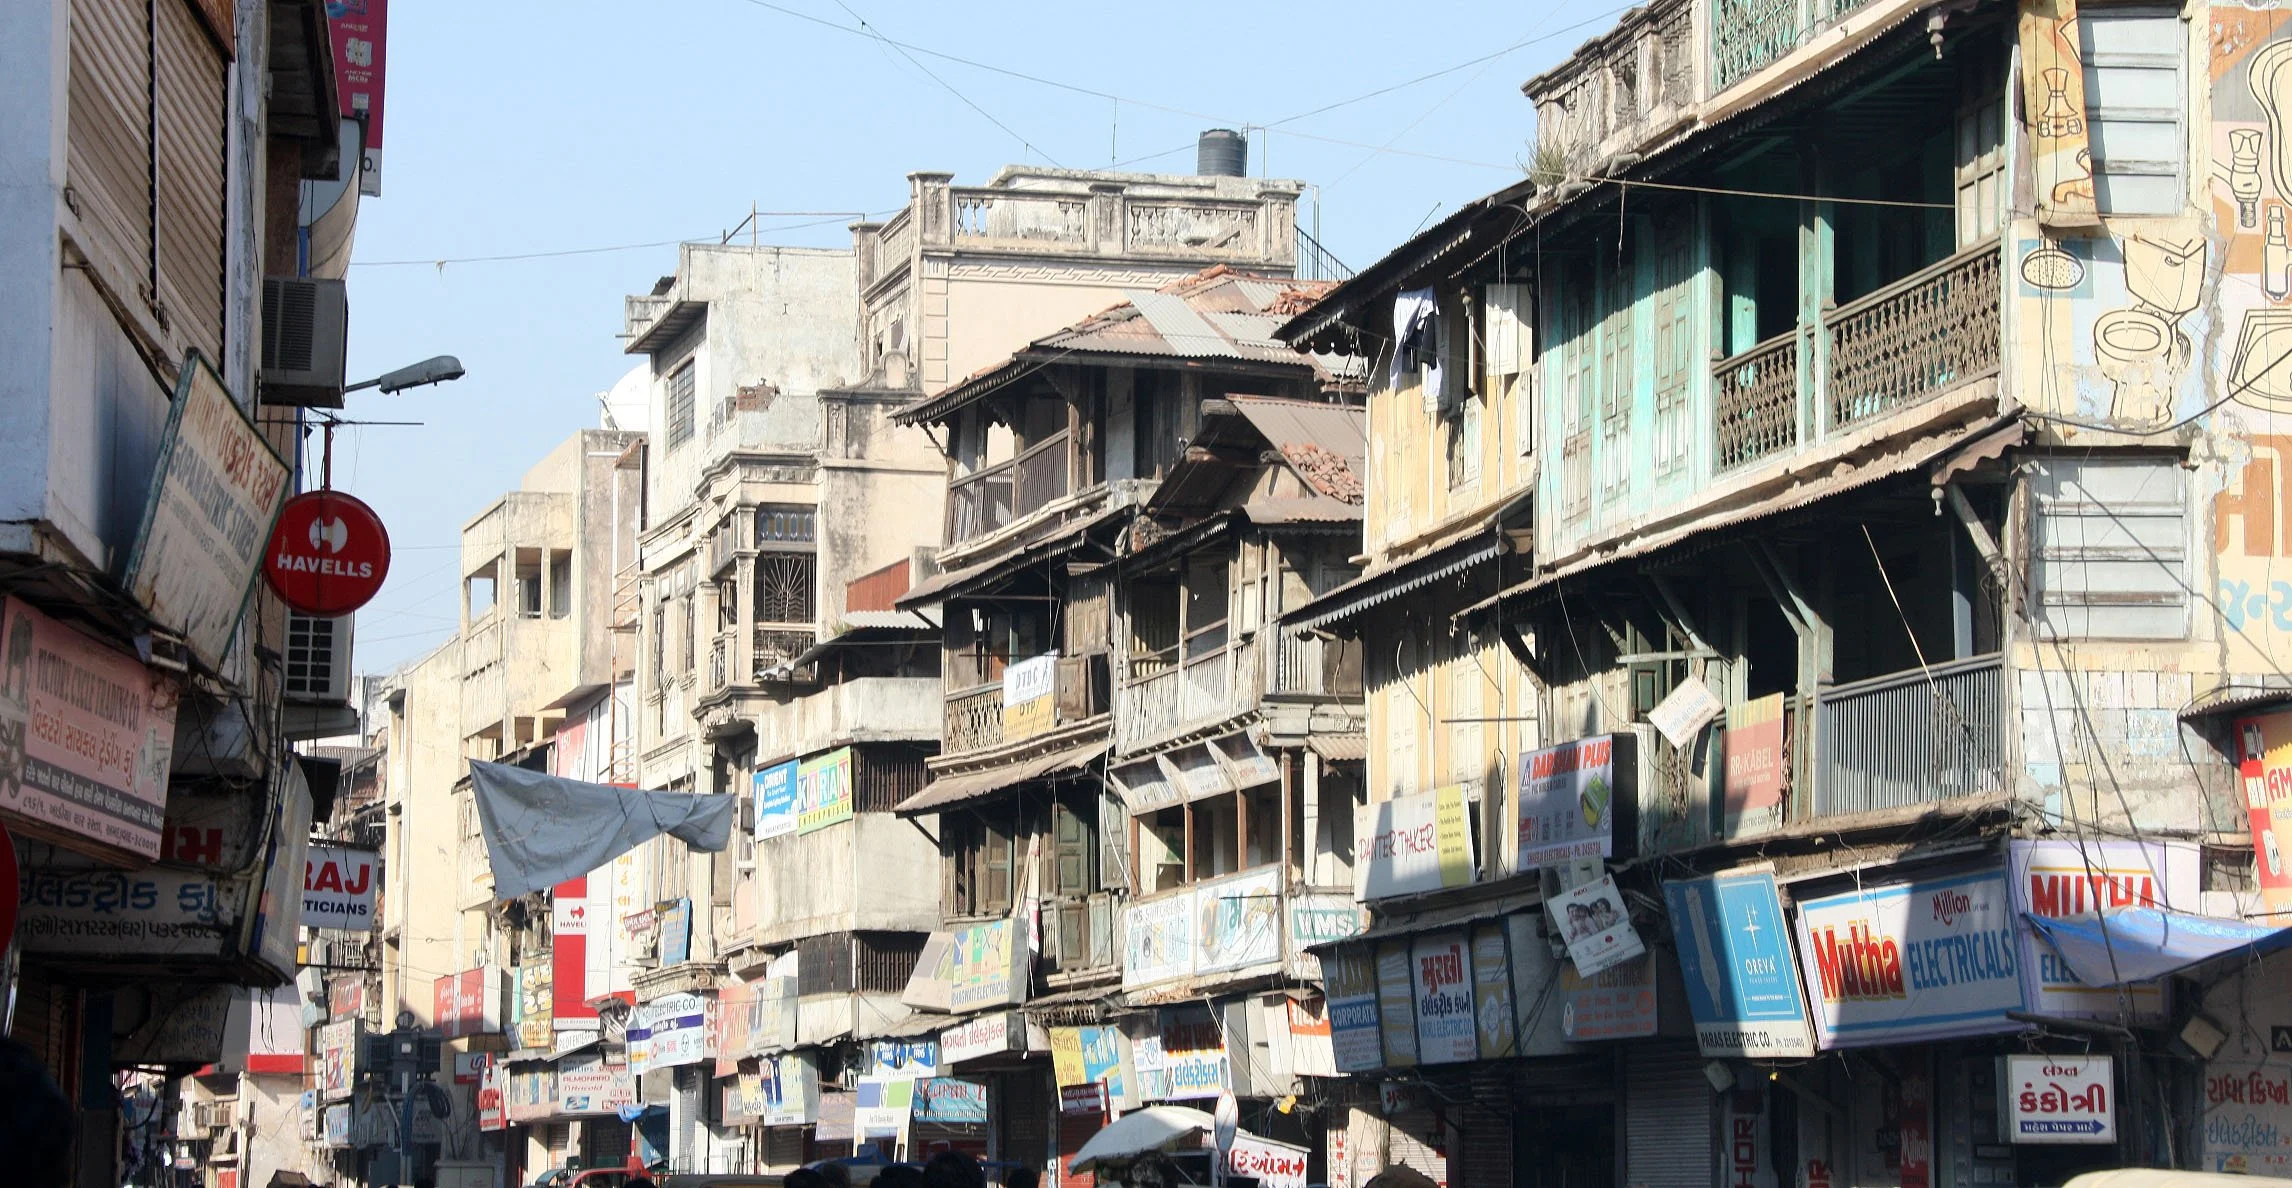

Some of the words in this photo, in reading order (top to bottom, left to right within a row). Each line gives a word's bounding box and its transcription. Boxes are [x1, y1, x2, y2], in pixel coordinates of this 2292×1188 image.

[277, 553, 373, 578] HAVELLS
[1532, 746, 1581, 781] DARSHAN
[1583, 739, 1612, 769] PLUS
[303, 899, 367, 916] TICIANS
[1932, 890, 1971, 926] Million
[2030, 874, 2155, 918] MUTHA
[1746, 955, 1776, 975] OREVA
[1811, 919, 1906, 1003] Mutha
[1907, 928, 2015, 990] ELECTRICALS
[1700, 1032, 1734, 1049] PARAS
[1733, 1031, 1759, 1048] ELECTRIC
[1759, 1031, 1773, 1048] CO.
[2043, 1065, 2078, 1077] લગ્ન
[2020, 1082, 2106, 1113] કંકોત્રી
